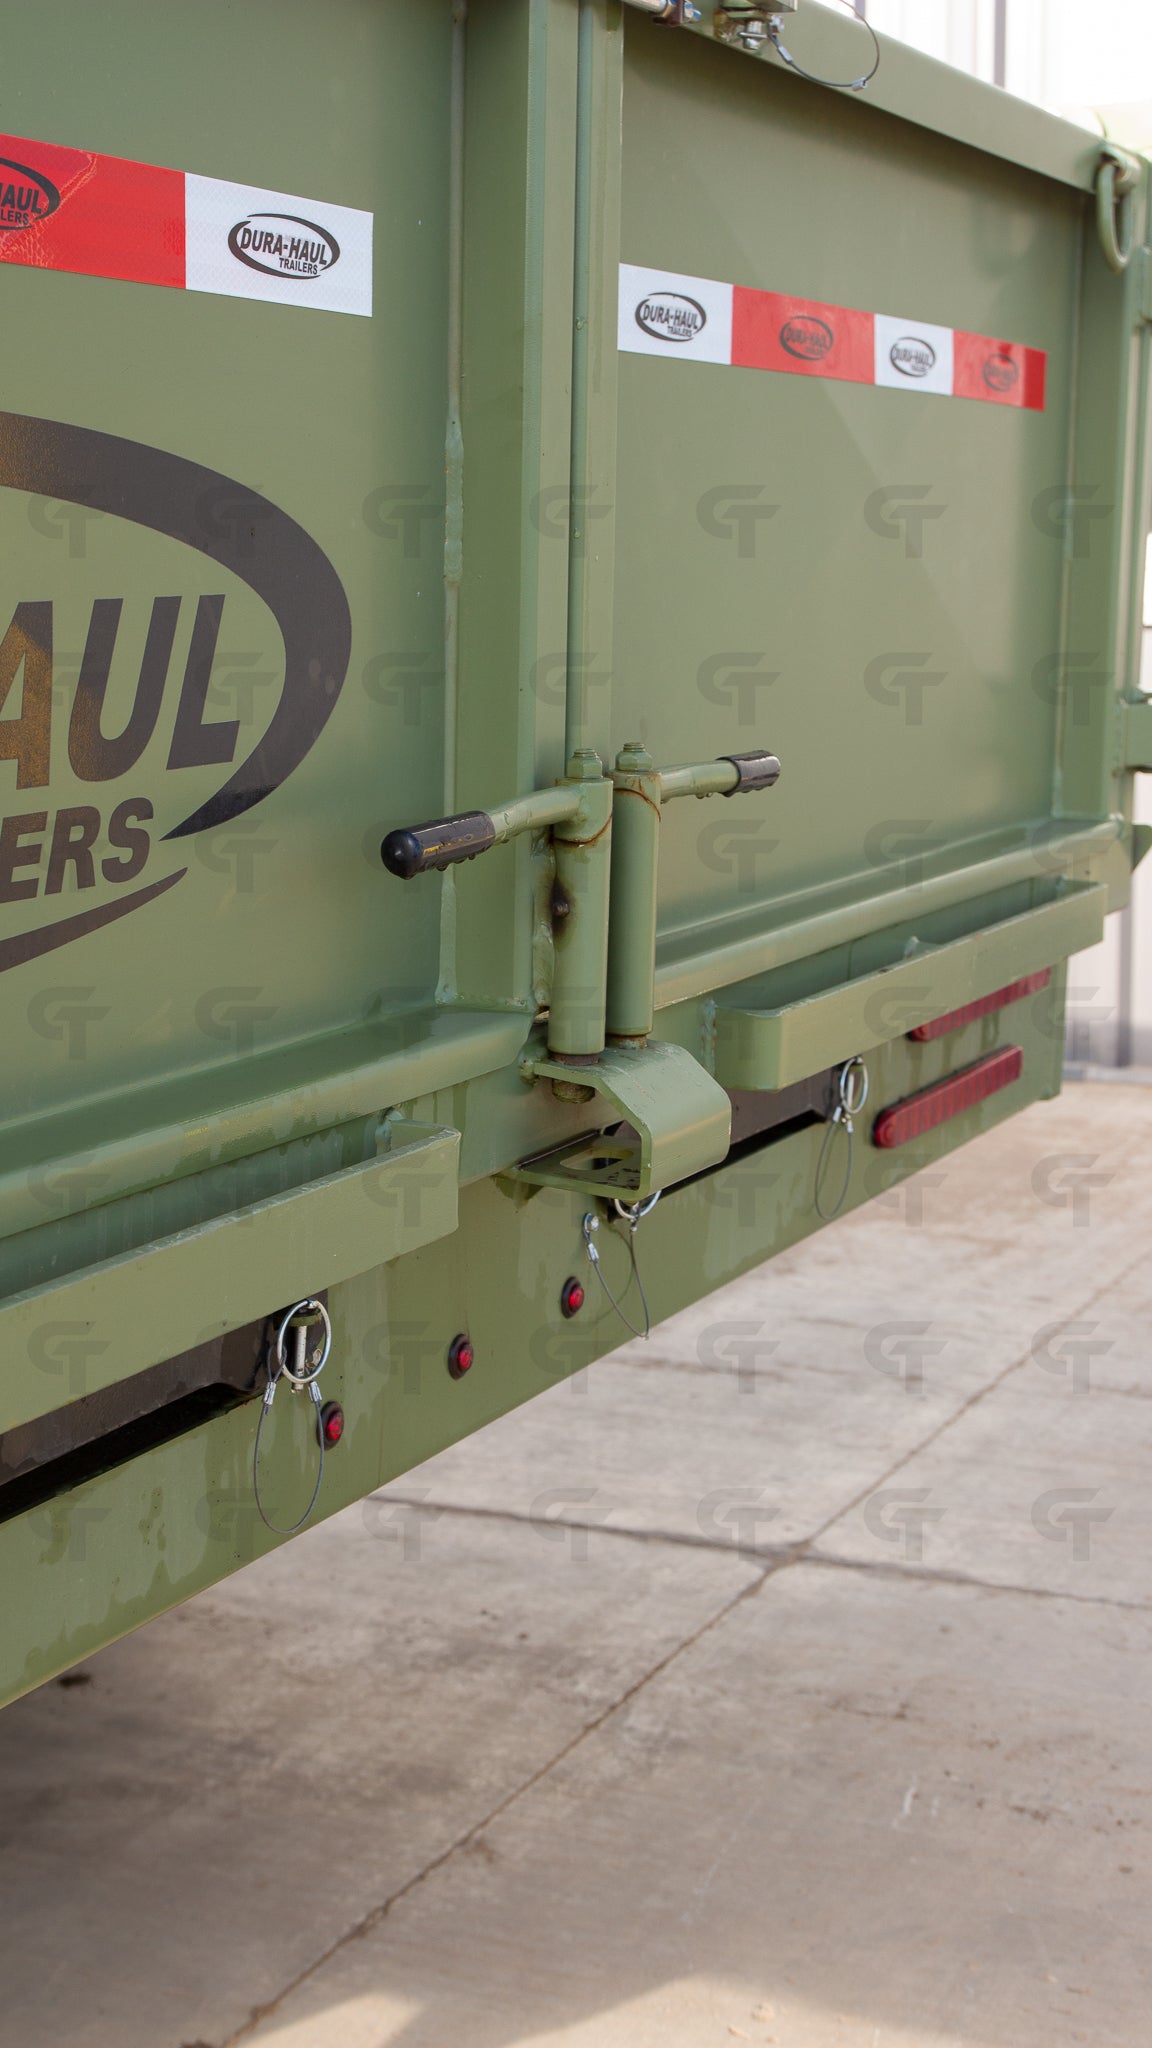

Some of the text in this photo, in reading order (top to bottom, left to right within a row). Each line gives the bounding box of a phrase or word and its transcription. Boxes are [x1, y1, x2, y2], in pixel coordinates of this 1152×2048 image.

[0, 182, 43, 215] AUL
[239, 227, 328, 266] DURA-HAUL
[278, 256, 319, 275] TRAILERS
[642, 304, 698, 330] DURA-HAUL
